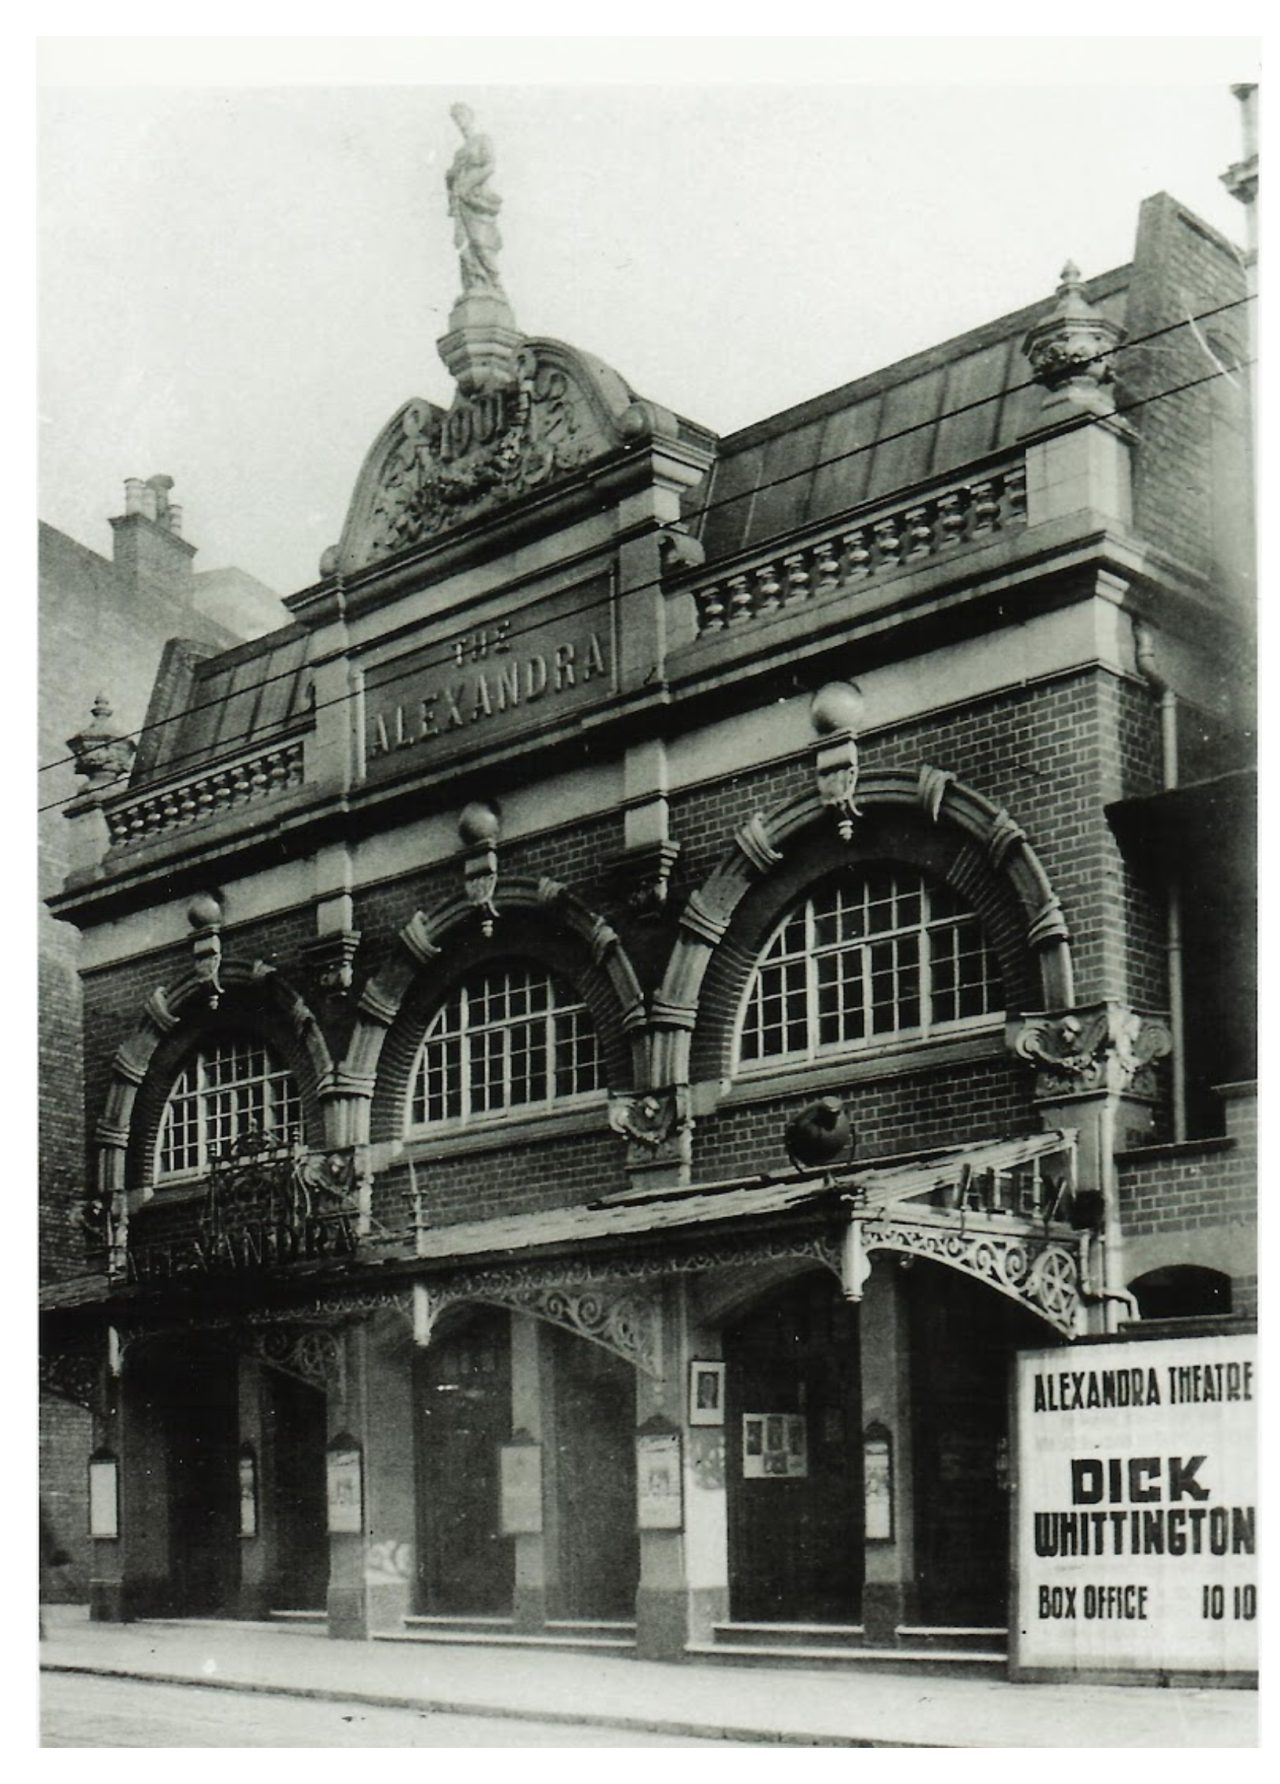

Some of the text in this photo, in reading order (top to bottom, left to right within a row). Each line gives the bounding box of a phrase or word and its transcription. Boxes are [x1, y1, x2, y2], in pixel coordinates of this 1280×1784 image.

[453, 618, 512, 669] THE
[369, 632, 606, 757] ALEXANDRA
[1034, 1361, 1254, 1413] ALEXANDRA THEATRE
[1070, 1455, 1211, 1505] DICK
[1034, 1506, 1256, 1557] WHITTINGTON
[1038, 1584, 1077, 1620] BOX
[1083, 1584, 1149, 1620] OFFICE
